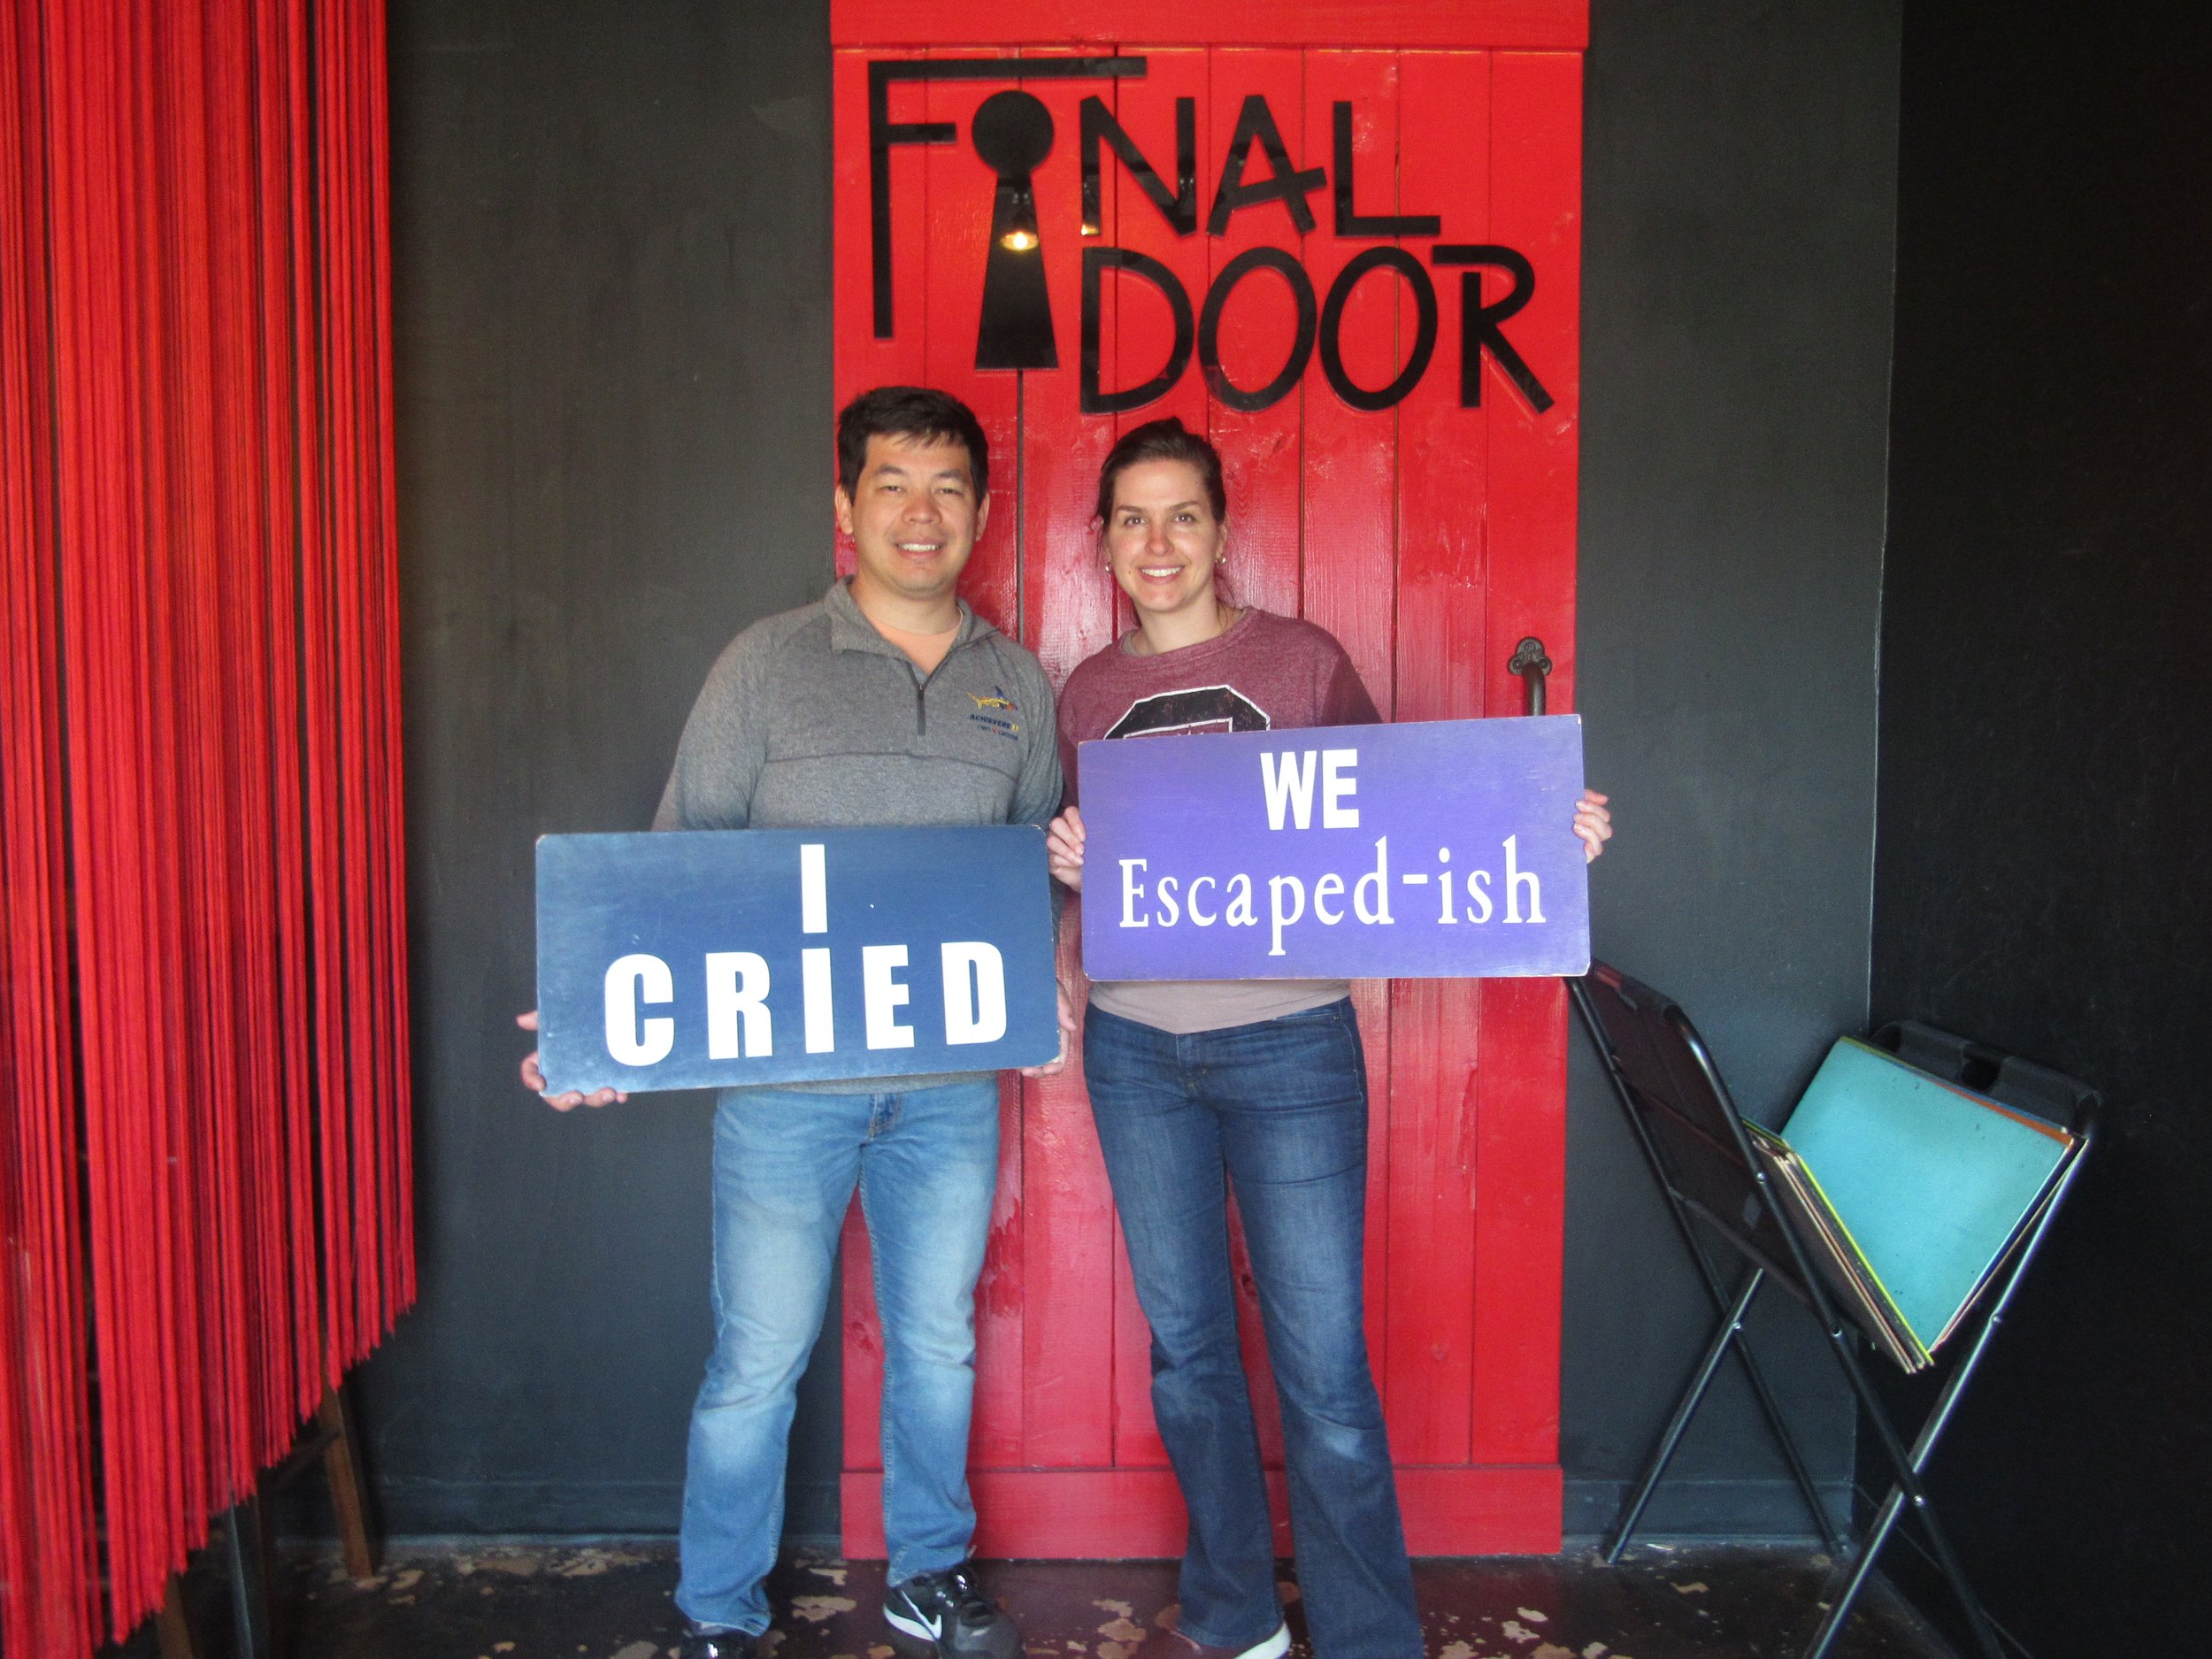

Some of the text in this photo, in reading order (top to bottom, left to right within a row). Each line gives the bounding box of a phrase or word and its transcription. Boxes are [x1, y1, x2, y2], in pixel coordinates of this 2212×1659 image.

[1080, 244, 1555, 415] DOOR
[1259, 749, 1360, 831] WE
[800, 843, 828, 934] I
[1118, 833, 1547, 956] Escaped-ish
[604, 941, 1008, 1067] CRIED
